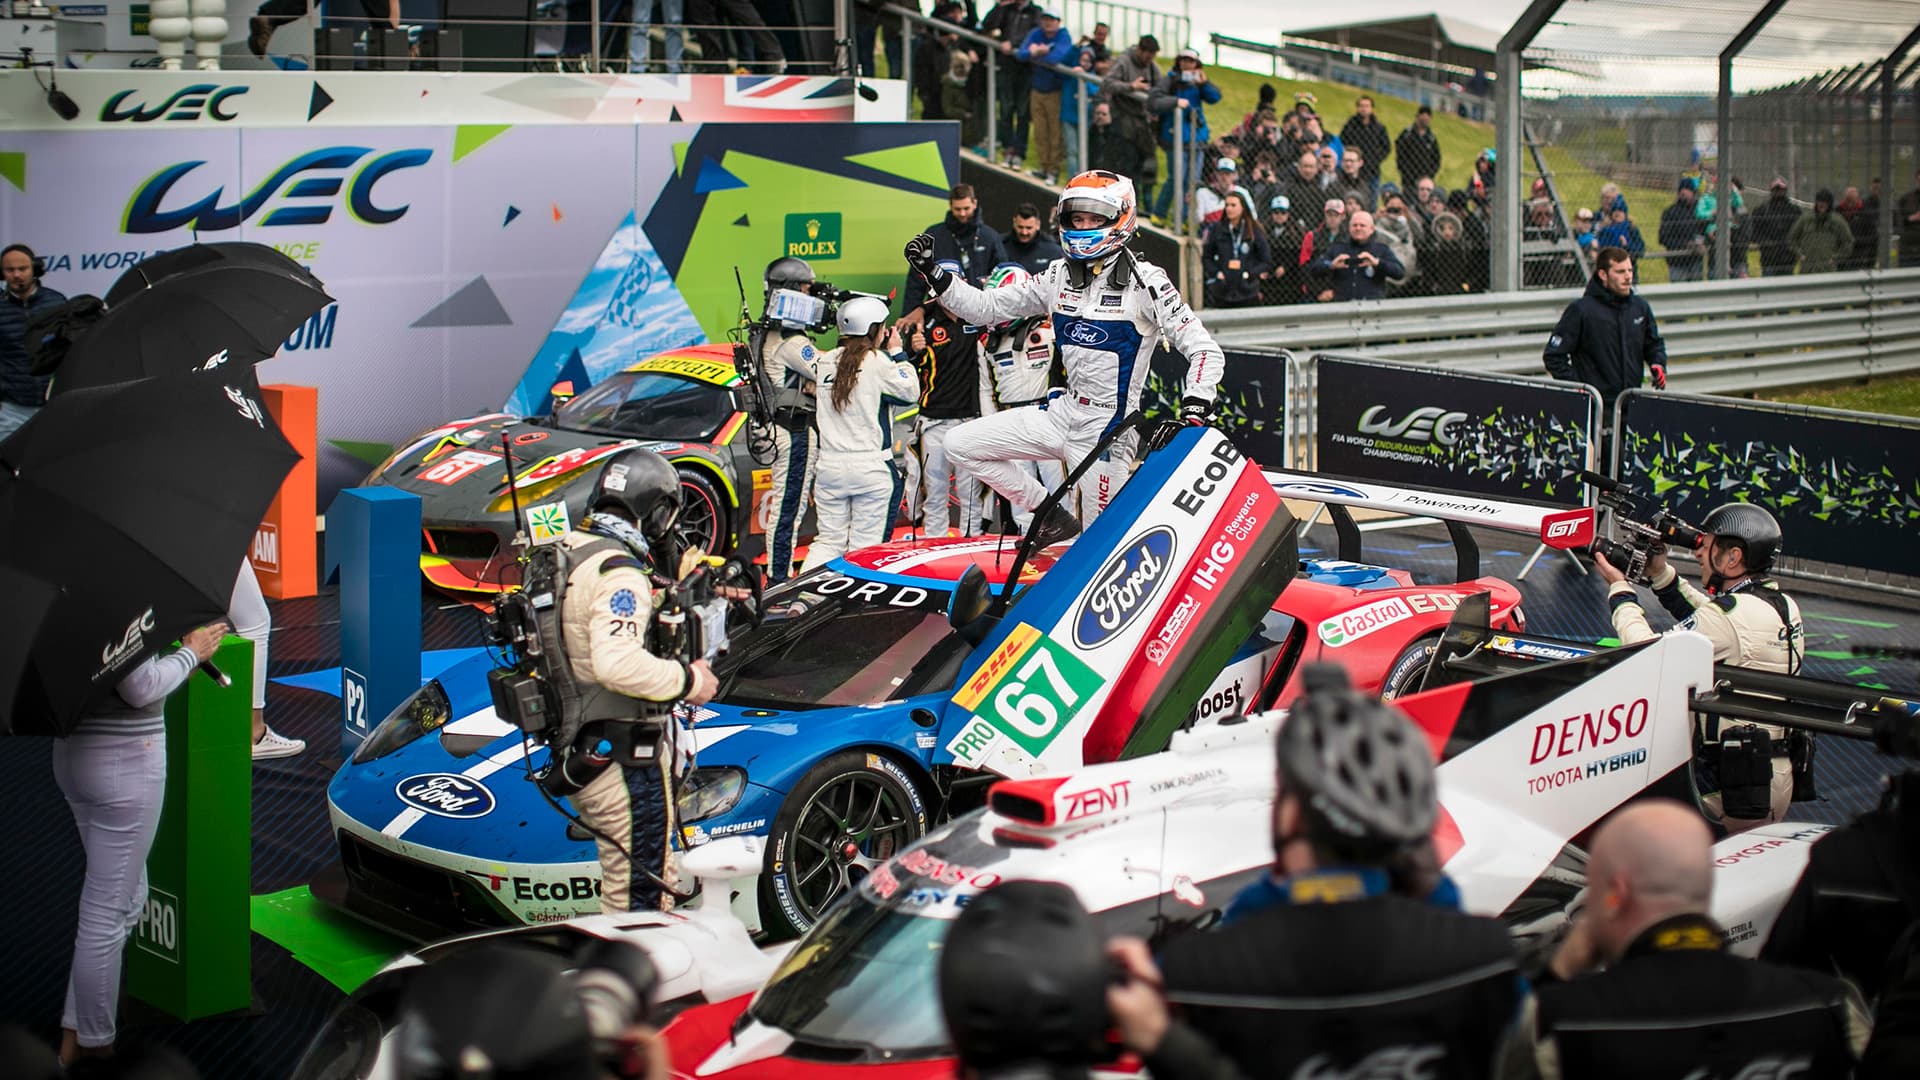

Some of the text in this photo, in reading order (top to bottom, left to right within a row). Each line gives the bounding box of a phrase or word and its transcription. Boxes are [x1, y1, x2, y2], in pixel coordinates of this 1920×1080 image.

[100, 84, 250, 122] WEC
[121, 146, 433, 234] WEC
[788, 241, 836, 256] ROLEX
[1071, 324, 1097, 344] Ford
[1332, 434, 1426, 454] FIA WORLD ENDURANCE
[1358, 405, 1468, 445] WEC
[1362, 448, 1424, 463] CHAMPIONSHIP
[1225, 491, 1260, 535] Rewards
[1403, 495, 1502, 516] Powered by
[253, 529, 276, 564] AM
[1235, 516, 1257, 541] Club
[1547, 516, 1590, 538] GT
[872, 548, 930, 567] FORD
[1192, 540, 1235, 590] IHG
[1091, 545, 1161, 630] Ford
[103, 608, 155, 664] WEC
[1342, 600, 1406, 636] Castrol
[970, 641, 1023, 695] DHL
[1391, 651, 1423, 687] MICHELIN
[346, 678, 366, 729] P2
[994, 646, 1079, 738] 67
[954, 722, 995, 761] PRO
[1529, 698, 1649, 765] DENSO
[884, 763, 921, 808] MICHELIN
[1528, 747, 1647, 795] TOYOTA HYBRID
[406, 777, 479, 811] Ford
[1062, 780, 1131, 822] ZENT
[711, 819, 766, 836] MICHELIN
[138, 899, 176, 950] PRO
[776, 878, 809, 934] MICHELIN
